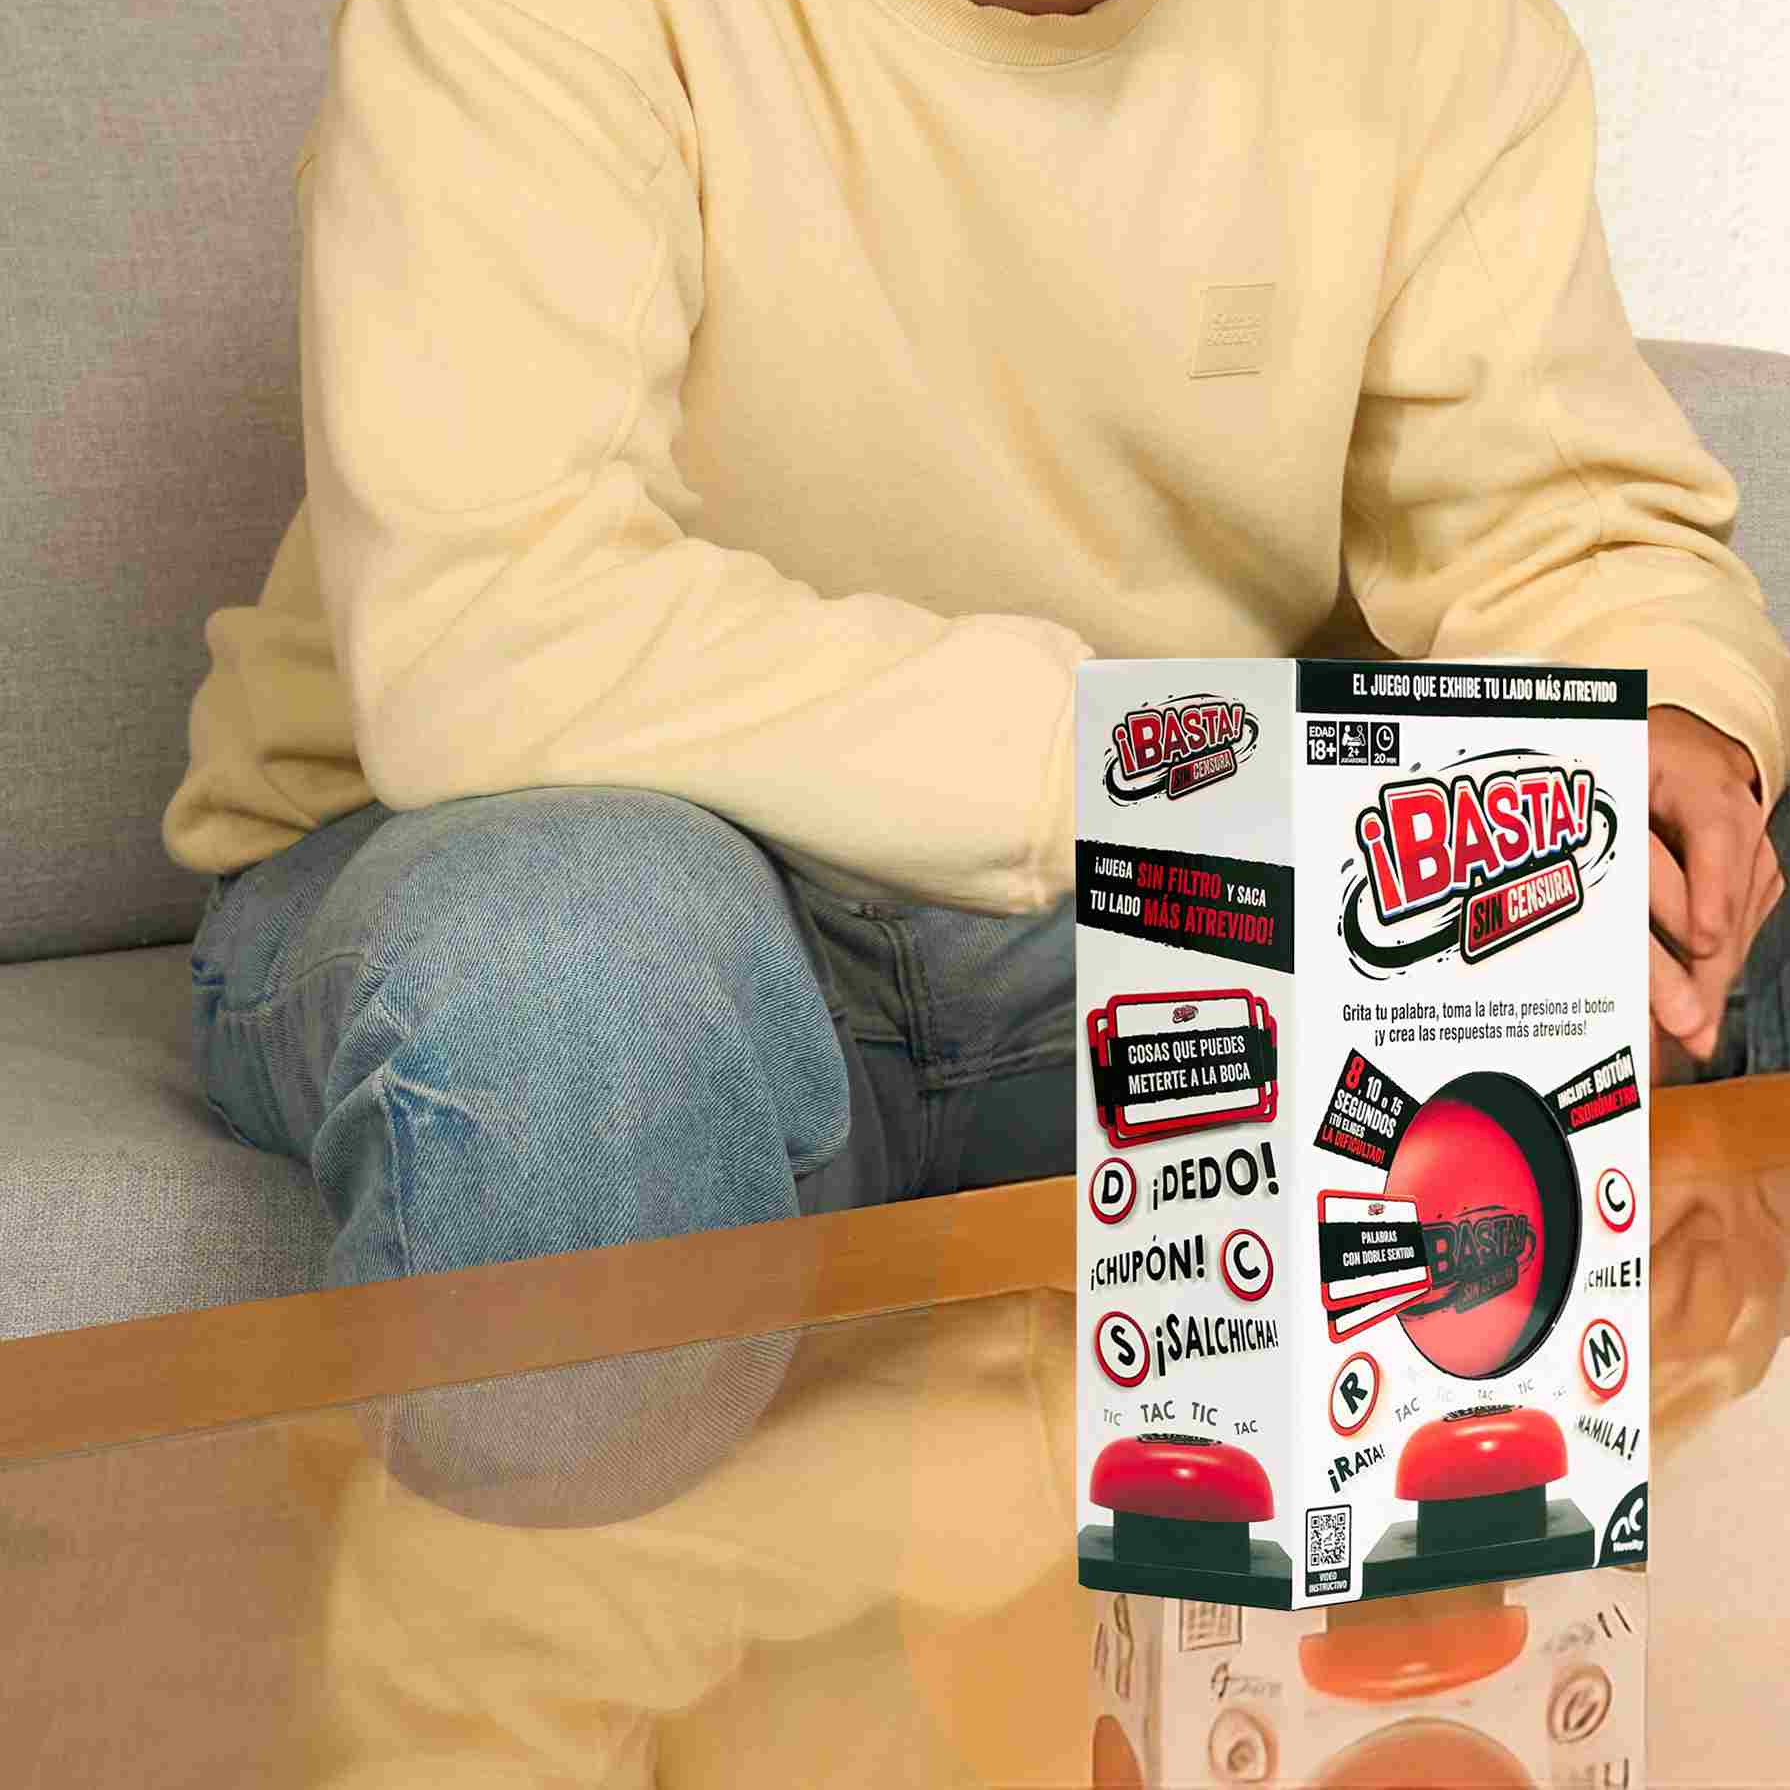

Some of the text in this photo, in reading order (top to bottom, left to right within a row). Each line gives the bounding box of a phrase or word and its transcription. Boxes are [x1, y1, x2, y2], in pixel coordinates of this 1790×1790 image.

[1353, 674, 1617, 703] EL JUEGO QUE EXHIBE TU LADO MÁS ATREVIDO
[1115, 704, 1244, 775] ¡BASTA!
[1308, 739, 1337, 761] 18+
[1309, 725, 1336, 738] EDAD
[1347, 746, 1360, 758] 2+
[1374, 753, 1386, 764] 20
[1358, 771, 1591, 915] ¡BASTA!
[1095, 856, 1266, 907] ¡JUEGA SIN FILTRO Y SACA
[1090, 889, 1275, 946] TU LADO MÁS ATREVIDO!
[1472, 867, 1574, 942] SIN CENSURA
[1343, 998, 1615, 1023] Grita tu palabra, toma la letra, presiona el botón
[1128, 1035, 1246, 1065] COSAS QUE PUEDES
[1374, 1020, 1587, 1047] ¡y crea las respuestas más atrevidas!
[1128, 1062, 1251, 1095] METERTE A LA BOCA
[1366, 1076, 1382, 1102] 10
[1390, 1096, 1404, 1117] 15
[1557, 1053, 1634, 1110] INCLUYE BOTÓN
[1334, 1088, 1397, 1138] SEGUNDOS
[1321, 1124, 1334, 1143] LA
[1101, 1169, 1124, 1204] D
[1153, 1141, 1279, 1210] ¡DEDO!
[1605, 1178, 1627, 1212] C
[1343, 1245, 1415, 1267] CON DOBLE SENTIDO
[1361, 1229, 1398, 1244] PALABRAS
[1090, 1234, 1205, 1292] ¡CHUPÓN!
[1233, 1240, 1262, 1280] C
[1110, 1325, 1136, 1366] S
[1155, 1313, 1279, 1377] ¡SALCHICHA!
[1588, 1329, 1621, 1379] M
[1339, 1372, 1368, 1415] R
[1394, 1397, 1421, 1424] TAC
[1517, 1380, 1535, 1395] TIC
[1103, 1400, 1259, 1435] TIC TAC TIC TAC
[1328, 1443, 1385, 1494] ¡RATA!
